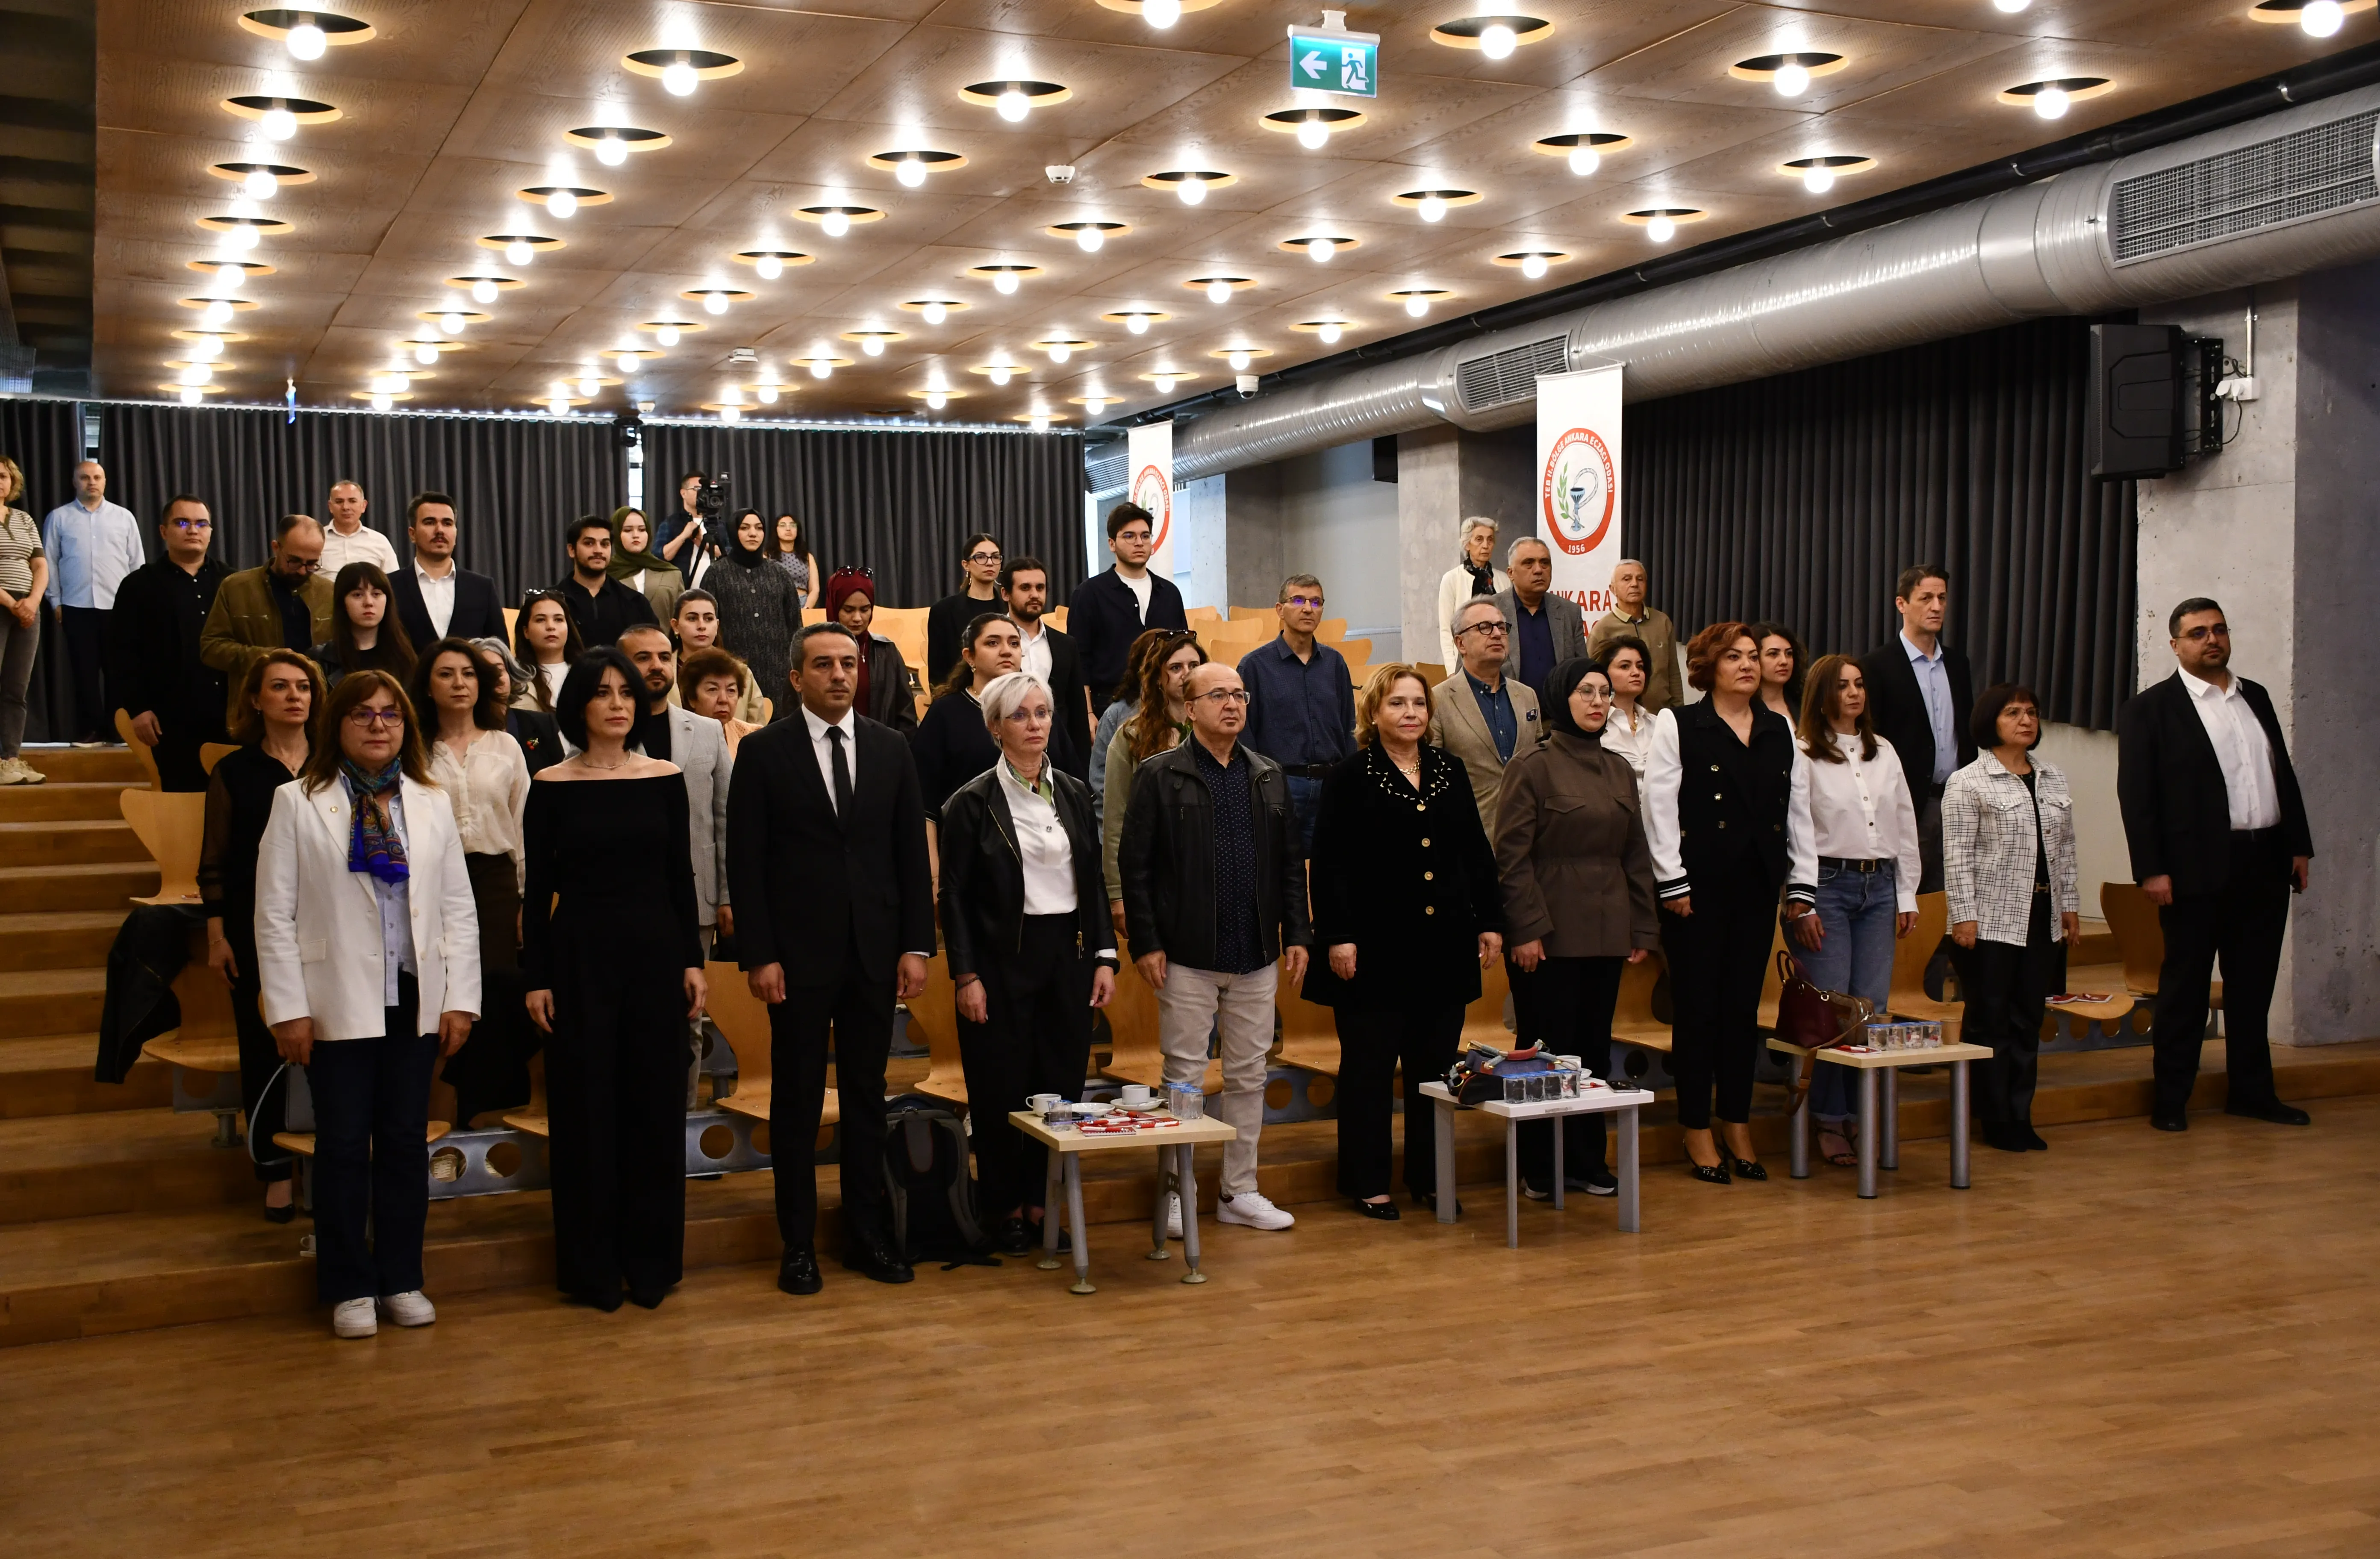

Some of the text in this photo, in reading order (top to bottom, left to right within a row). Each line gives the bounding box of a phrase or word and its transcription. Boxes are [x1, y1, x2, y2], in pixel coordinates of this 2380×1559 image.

[1564, 432, 1589, 445] ANKARA
[1590, 436, 1608, 462] ECZACI
[1605, 462, 1613, 493] ODASI
[1568, 544, 1585, 553] 1956
[1550, 590, 1612, 612] KARA
